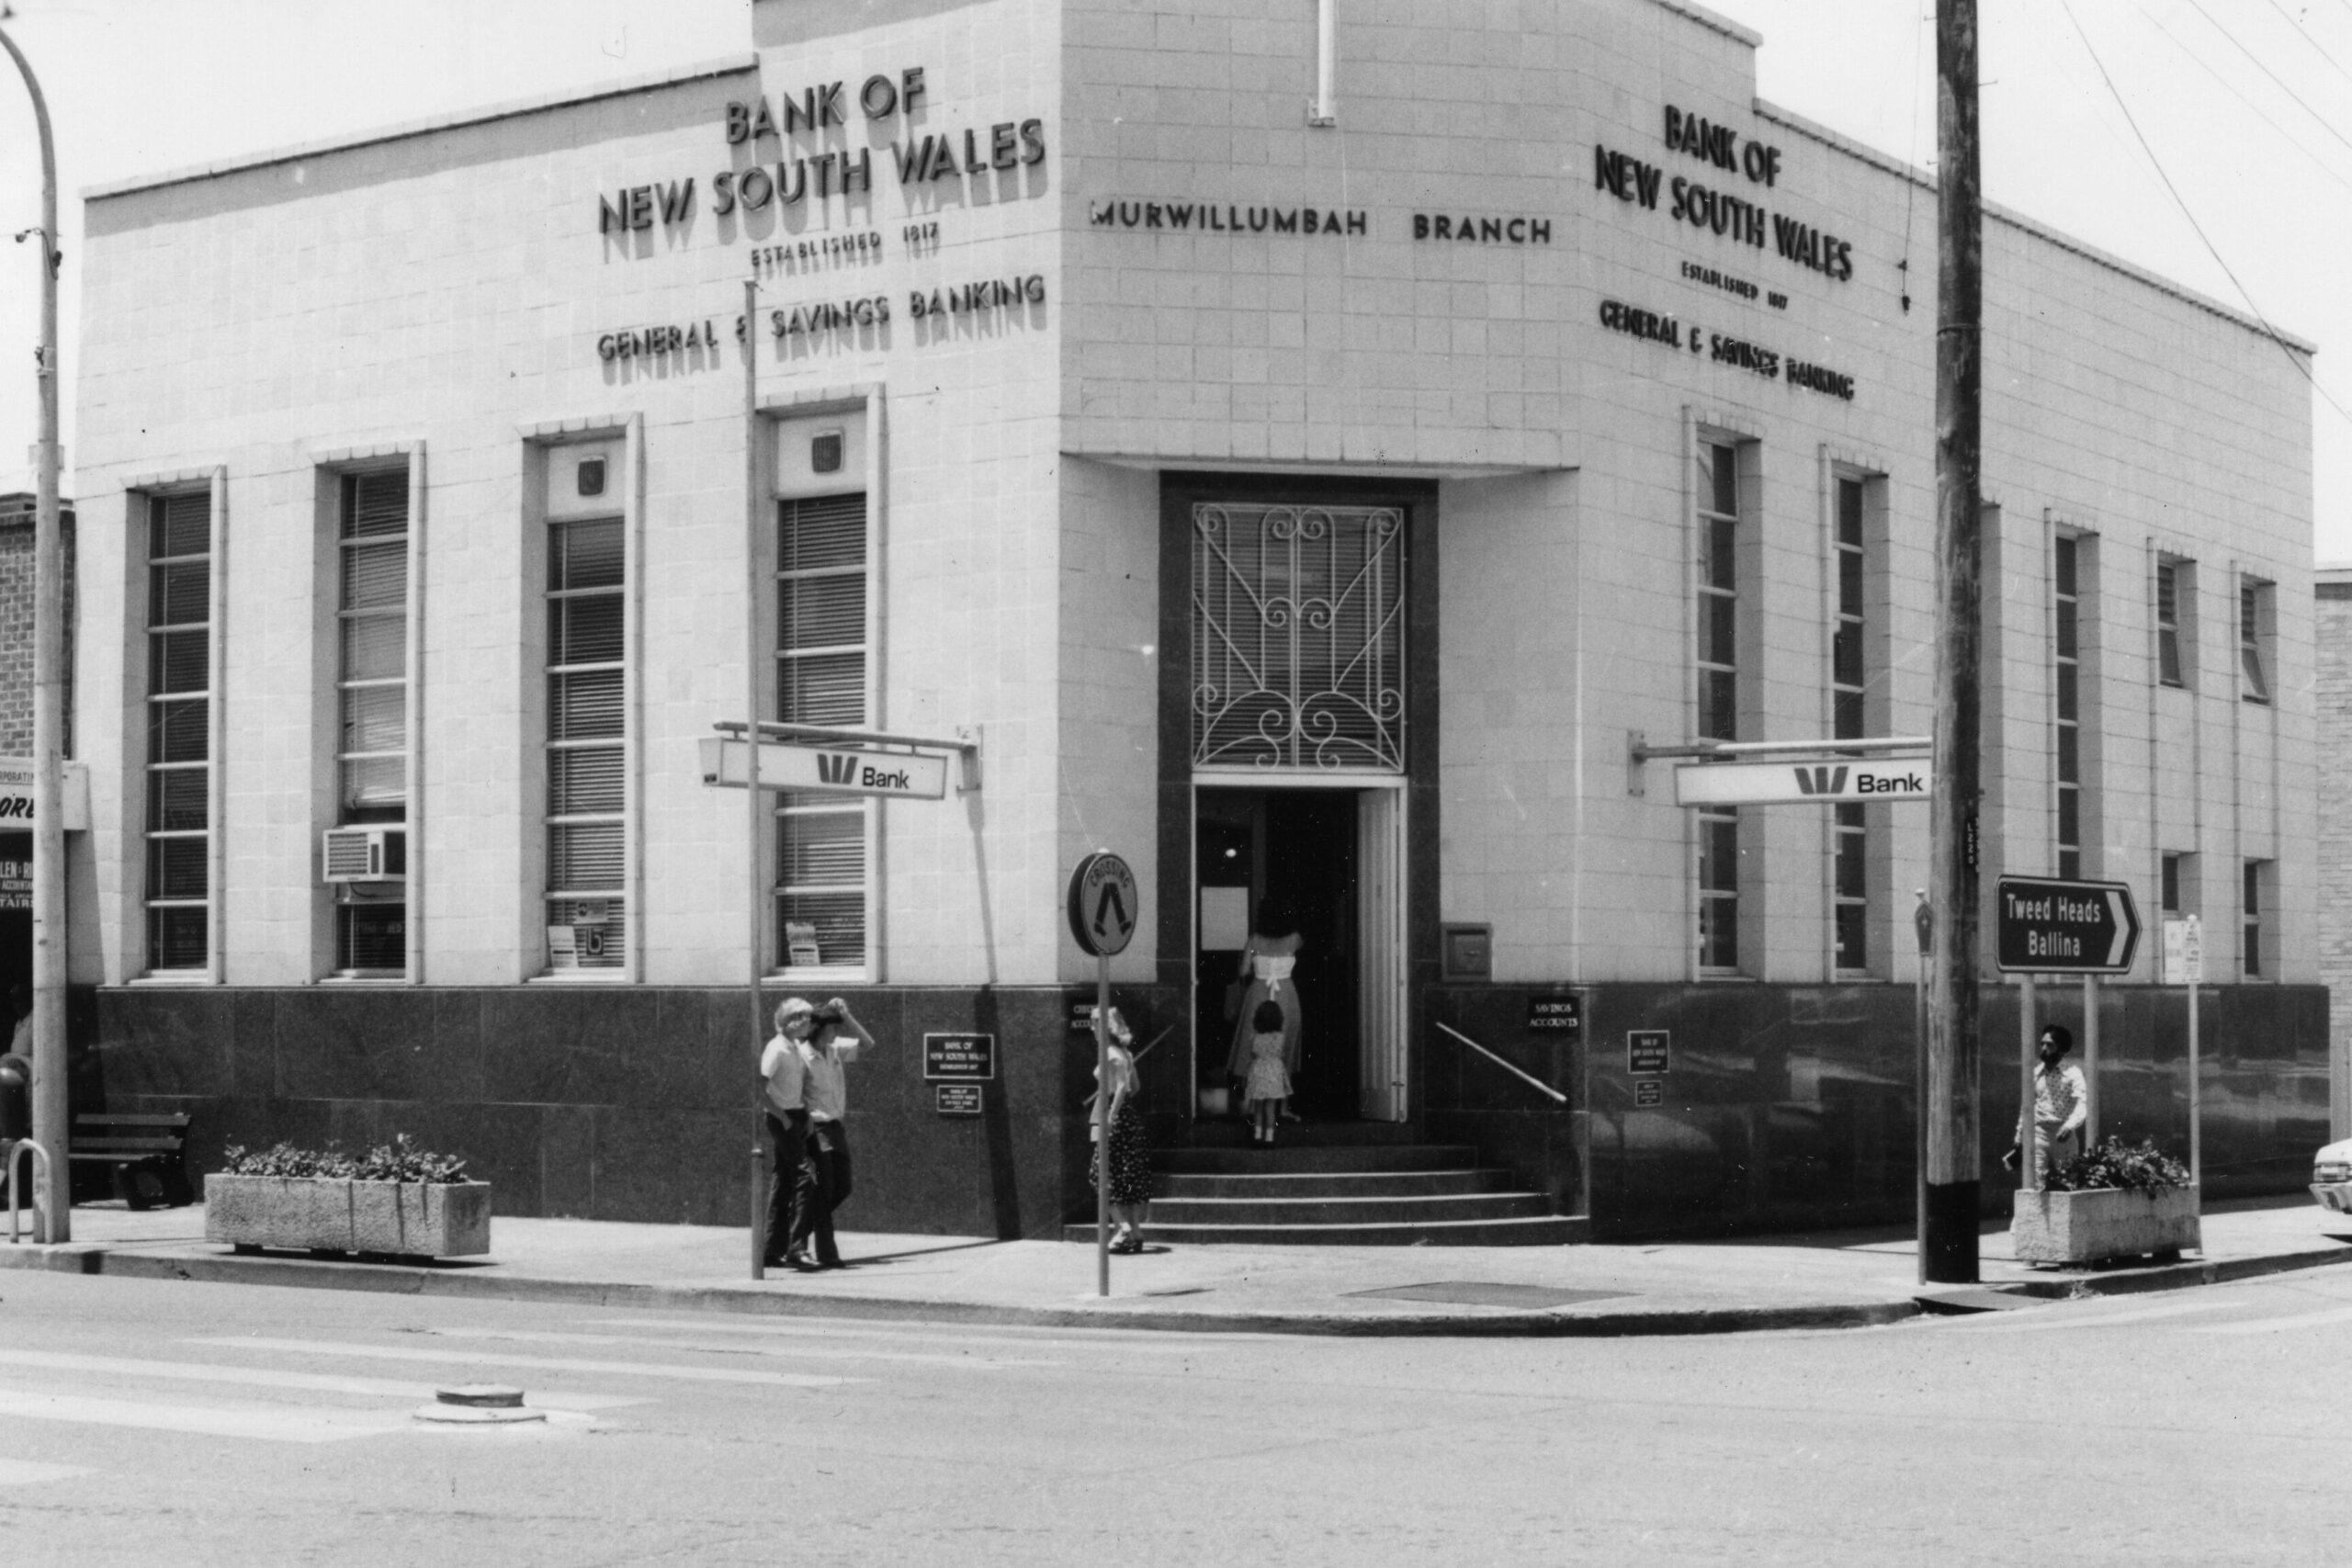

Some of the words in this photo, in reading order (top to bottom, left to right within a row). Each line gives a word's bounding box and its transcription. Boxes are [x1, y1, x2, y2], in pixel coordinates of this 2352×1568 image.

[725, 81, 846, 145] BANK
[860, 66, 925, 120] OF
[1664, 104, 1737, 173] BANK
[1745, 141, 1781, 186] OF
[598, 177, 695, 234] NEW
[713, 147, 870, 215] SOUTH
[892, 118, 1046, 184] WALES
[1091, 201, 1366, 235] MURWILLUMBAH
[1413, 213, 1552, 243] BRANCH
[1595, 143, 1662, 210] NEW
[1671, 176, 1765, 249] SOUTH
[1773, 213, 1853, 282] WALES
[751, 231, 881, 267] ESTABLISHED
[902, 221, 940, 243] 1817
[1681, 261, 1758, 299] ESTABLISHED
[597, 320, 718, 361] GENERAL
[771, 296, 889, 338] SAVINGS
[910, 275, 1046, 320] BANKING
[1600, 299, 1682, 348] GENERAL
[1711, 333, 1779, 378] SAVINGS
[1786, 357, 1854, 400] BANKING
[862, 766, 910, 789] Bank
[1857, 773, 1923, 794] Bank
[2007, 893, 2051, 920] Tweed
[2058, 896, 2101, 923] Heads
[2029, 930, 2081, 957] Ballina
[1530, 1018, 1578, 1027] ACCOUNTS
[1535, 1003, 1572, 1013] SAVINGS
